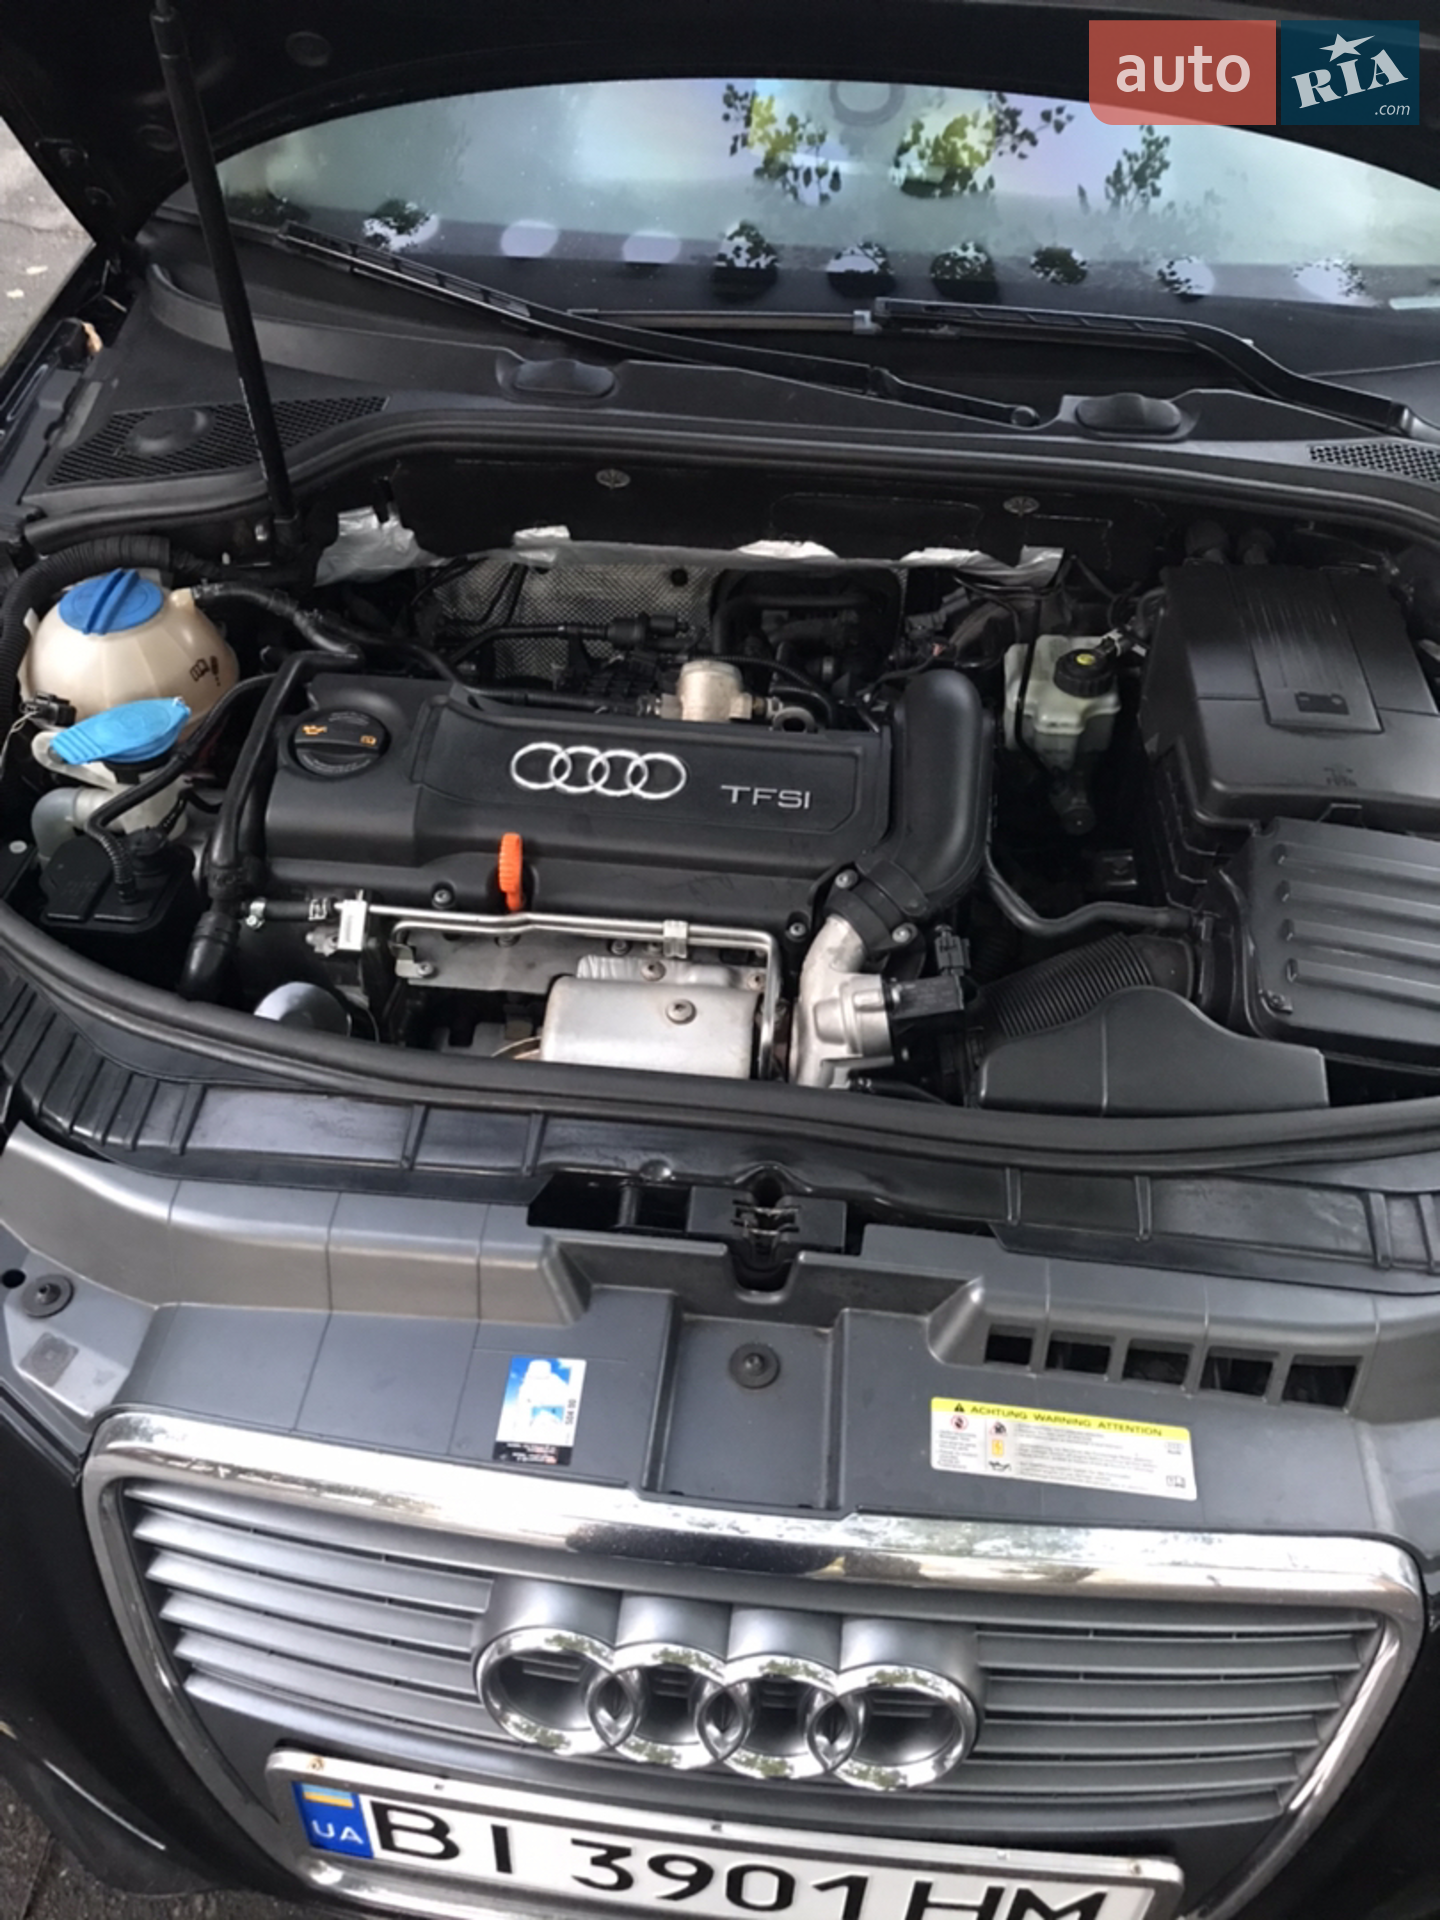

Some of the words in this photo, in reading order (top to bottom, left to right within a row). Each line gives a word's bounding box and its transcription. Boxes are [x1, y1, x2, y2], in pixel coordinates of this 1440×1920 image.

[720, 784, 811, 809] TFSI
[970, 1405, 1028, 1420] ACHTUNG
[1033, 1413, 1092, 1428] WARNING
[1097, 1421, 1163, 1437] ATTENTION
[311, 1821, 364, 1844] UA
[370, 1800, 513, 1875] BI
[570, 1837, 870, 1920] 3901
[901, 1879, 1108, 1920] HM
